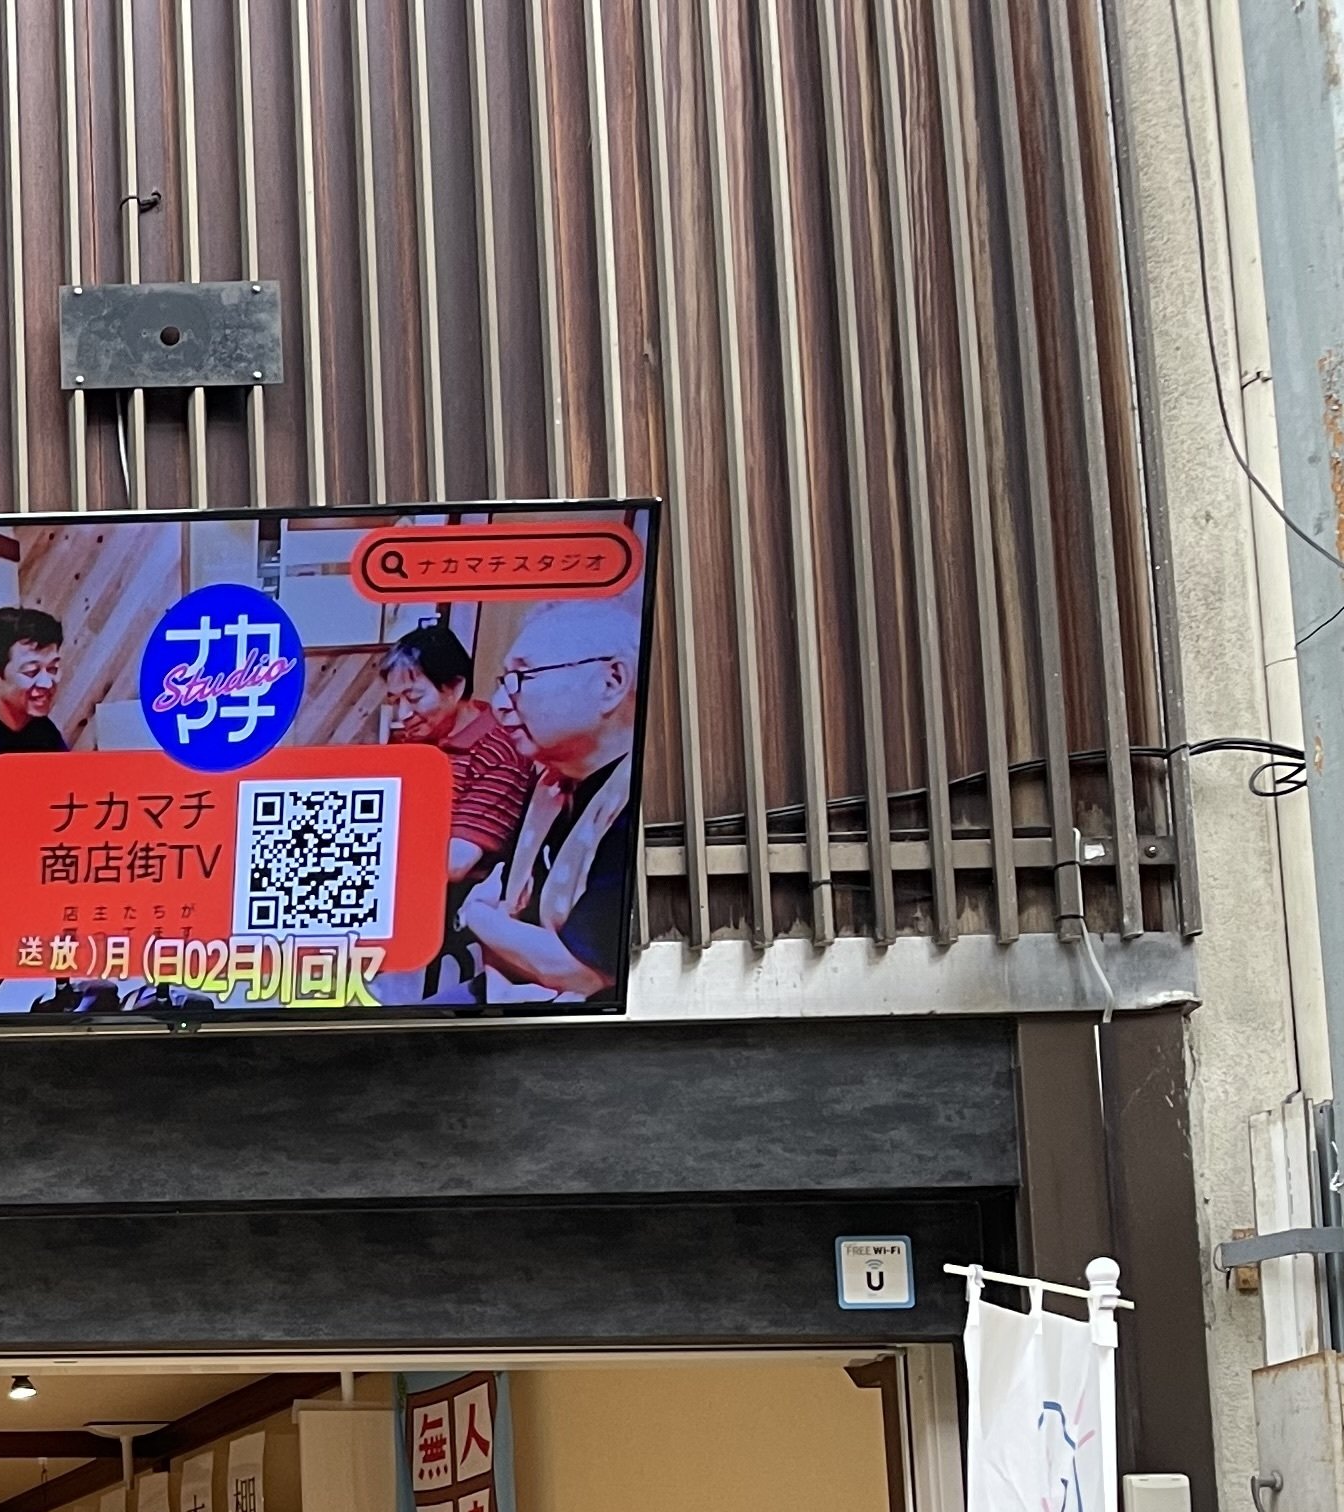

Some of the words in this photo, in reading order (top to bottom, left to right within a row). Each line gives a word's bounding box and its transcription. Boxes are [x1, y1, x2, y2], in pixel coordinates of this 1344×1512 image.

[417, 551, 607, 575] ナカマチスタジオ
[152, 649, 296, 712] Studio
[49, 791, 215, 833] ナカマチ
[41, 842, 222, 884] 商店街TV
